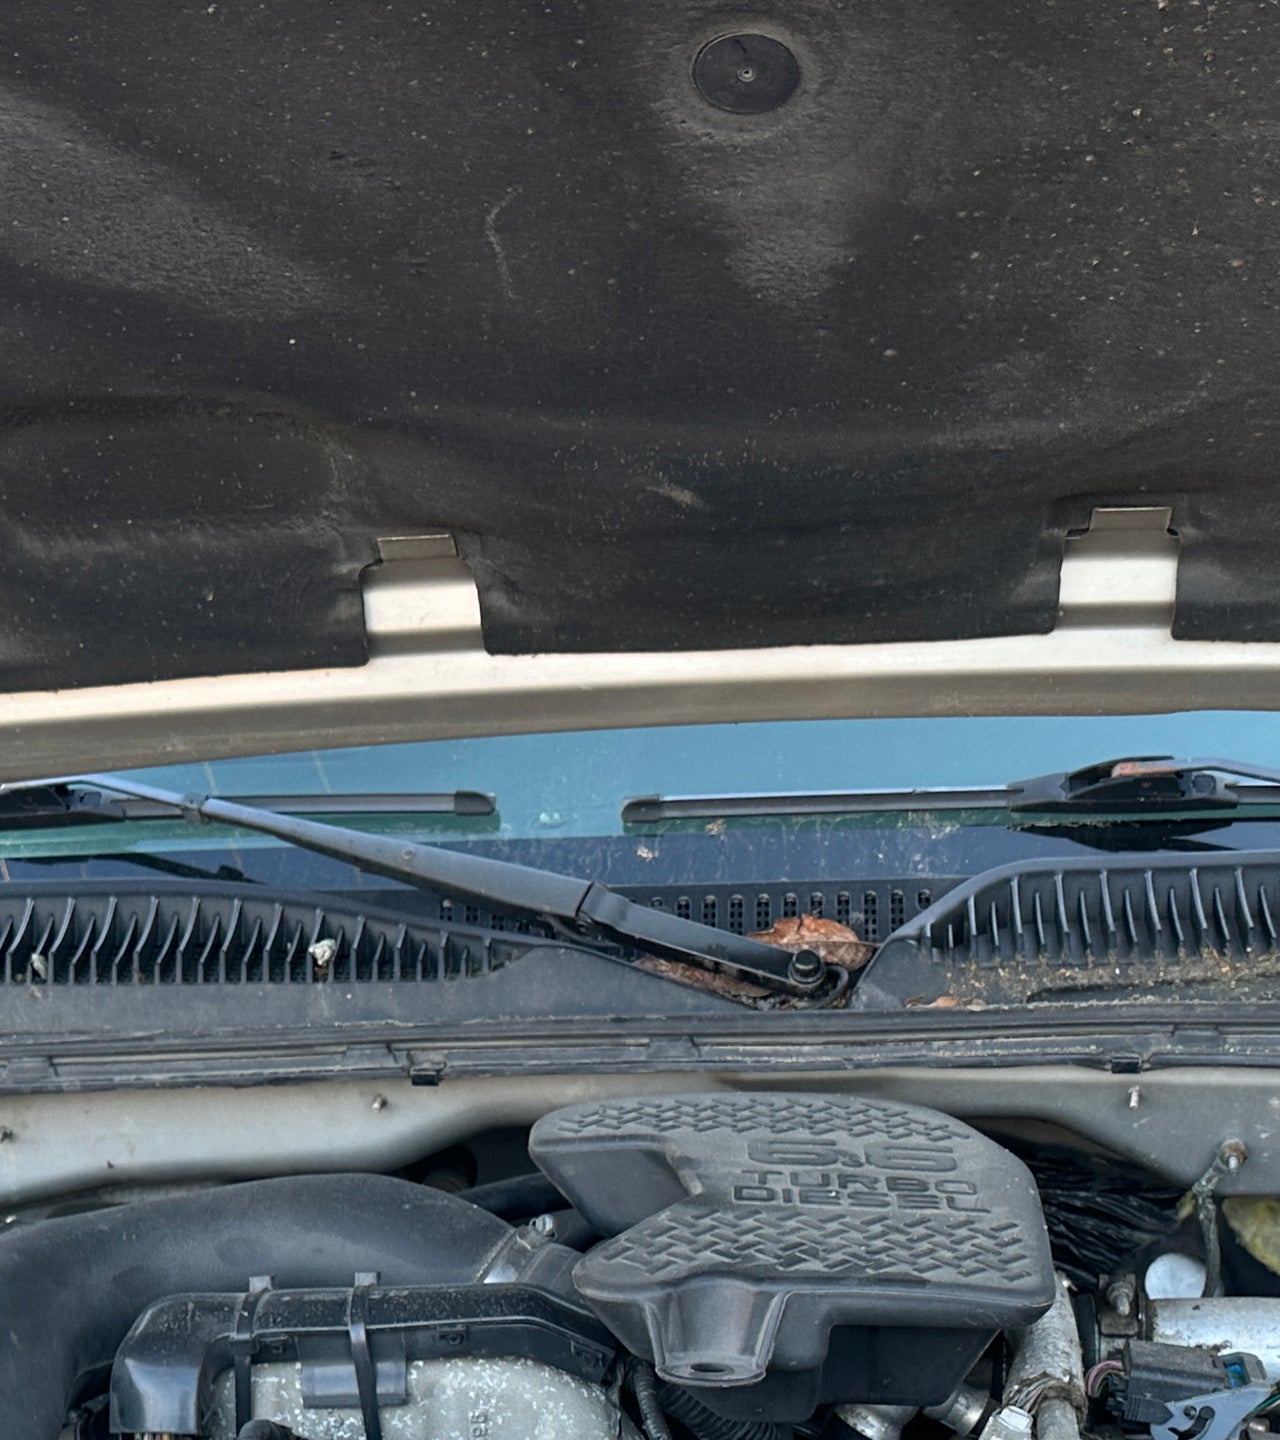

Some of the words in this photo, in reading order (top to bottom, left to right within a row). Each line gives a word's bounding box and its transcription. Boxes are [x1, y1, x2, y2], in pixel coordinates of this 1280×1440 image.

[747, 1138, 957, 1173] 6.6
[741, 1169, 978, 1196] TURBO
[733, 1184, 992, 1214] DIESEL
